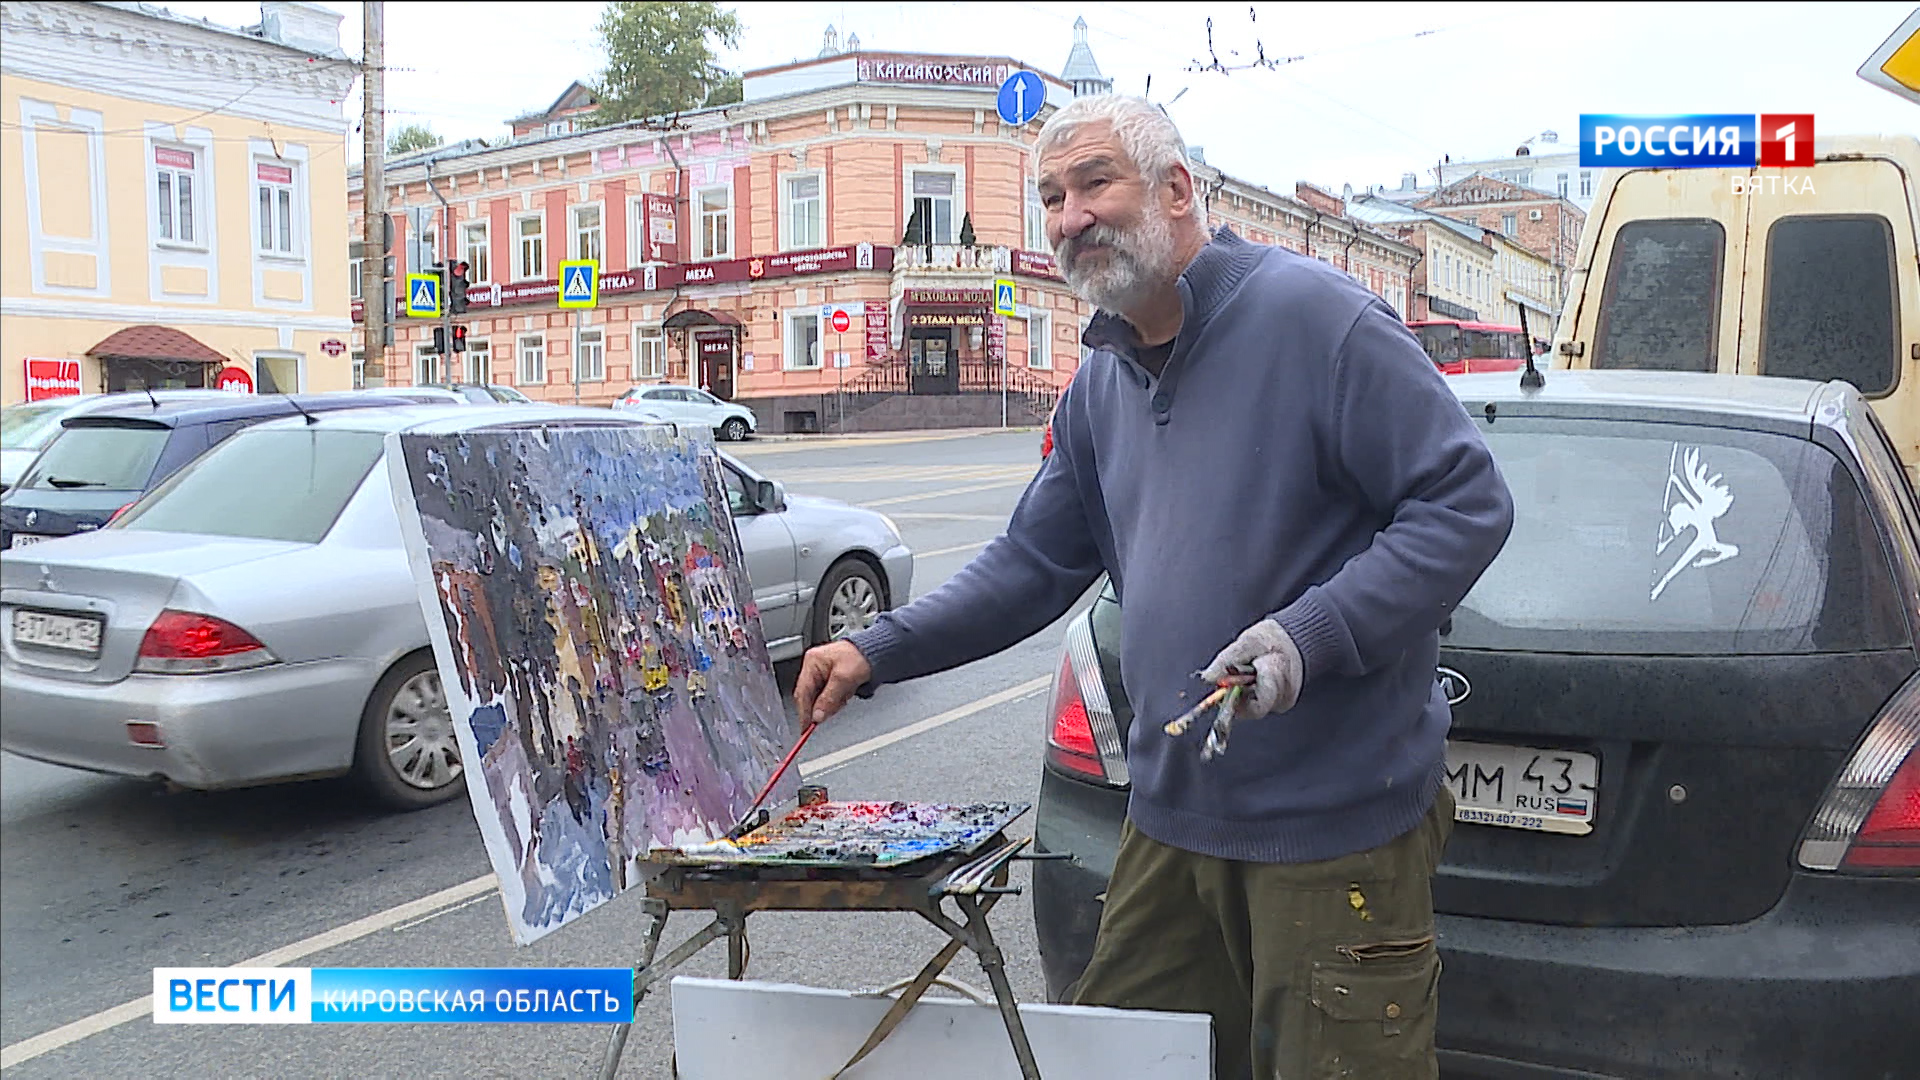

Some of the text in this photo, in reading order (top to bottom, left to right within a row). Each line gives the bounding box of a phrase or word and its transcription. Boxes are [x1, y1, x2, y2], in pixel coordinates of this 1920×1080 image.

[648, 199, 674, 214] МЕХА
[685, 267, 714, 281] МЕХА
[599, 276, 635, 290] ЯТКА»
[467, 291, 491, 303] АПКИ
[910, 291, 992, 304] МЕХОВАЯ МОДА
[911, 315, 985, 325] 2 ЭТАЖА МЕХА
[704, 343, 729, 352] МЕХА
[1522, 755, 1573, 794] 43
[1516, 795, 1556, 810] RUS
[1459, 811, 1543, 828] (8332) 407-222
